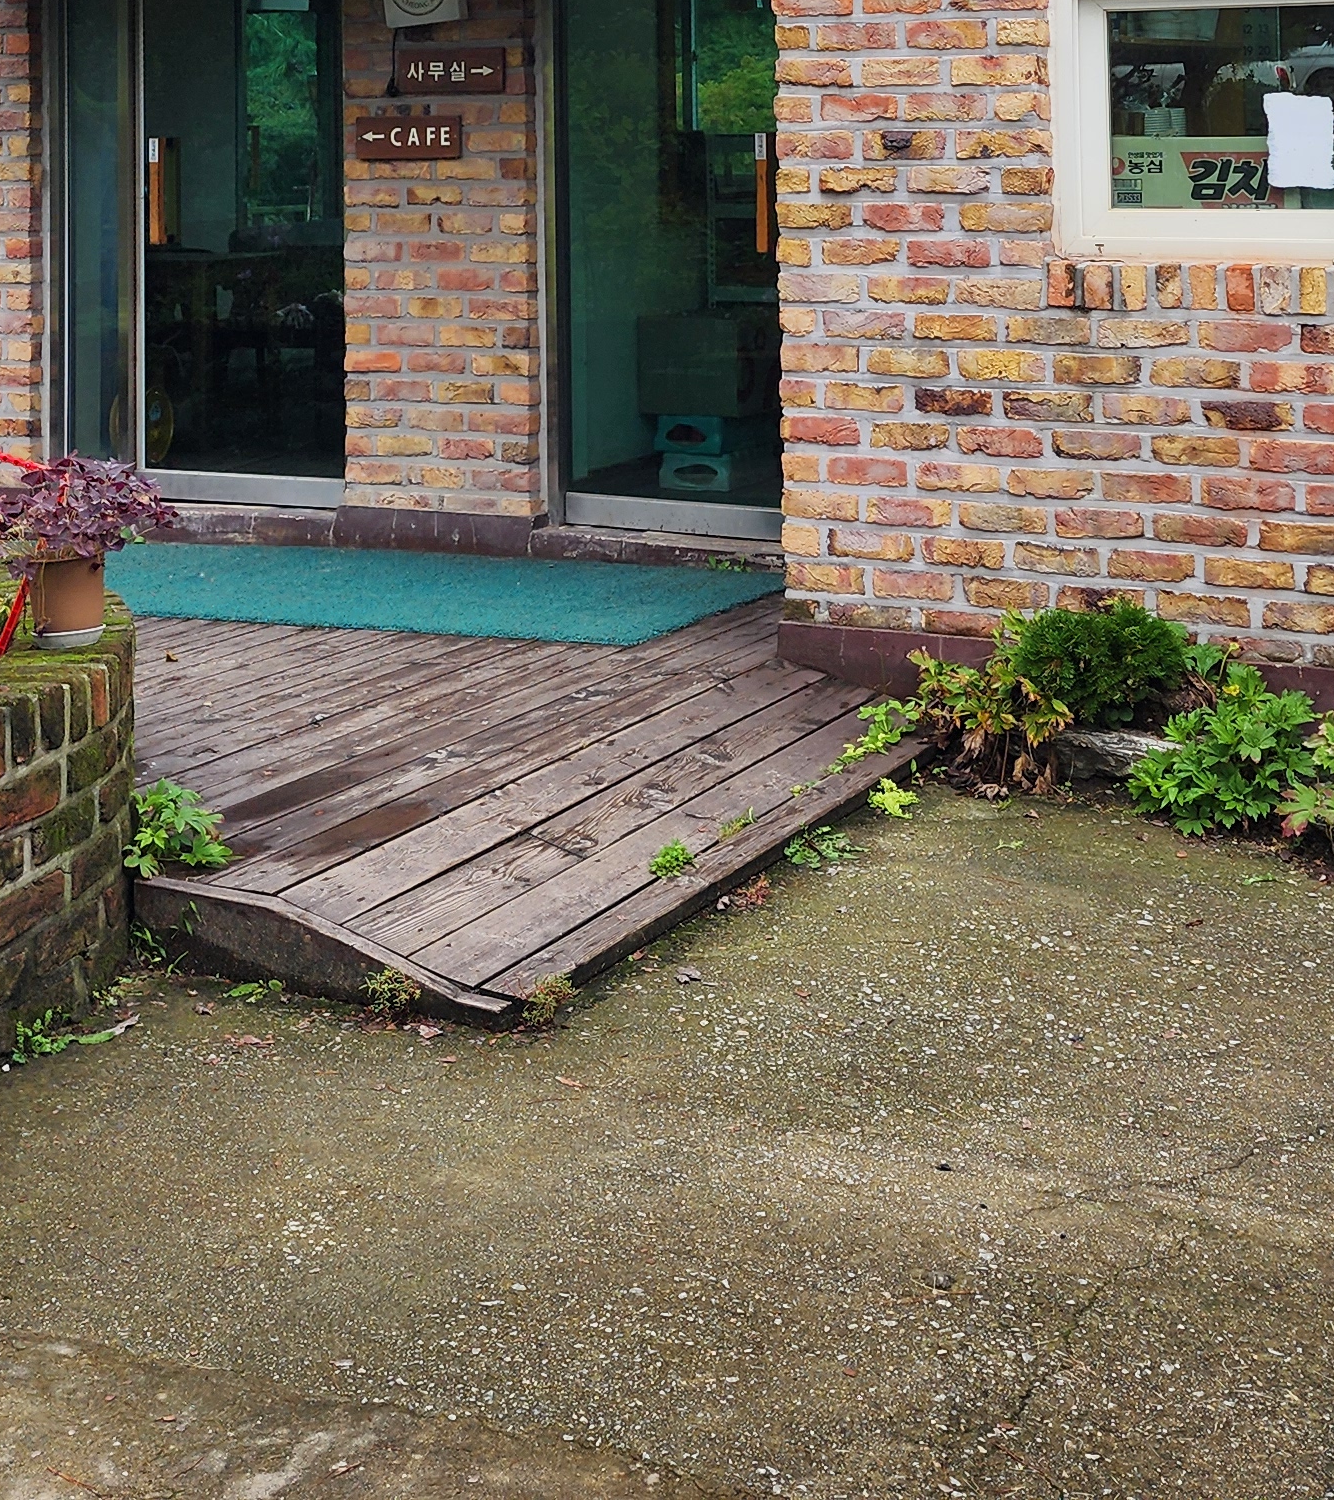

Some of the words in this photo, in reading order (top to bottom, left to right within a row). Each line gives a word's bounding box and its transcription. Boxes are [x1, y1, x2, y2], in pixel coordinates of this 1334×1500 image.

[407, 61, 466, 82] 사무실
[389, 126, 451, 147] CAFE
[1127, 159, 1163, 175] 농심
[1188, 158, 1269, 202] 김치
